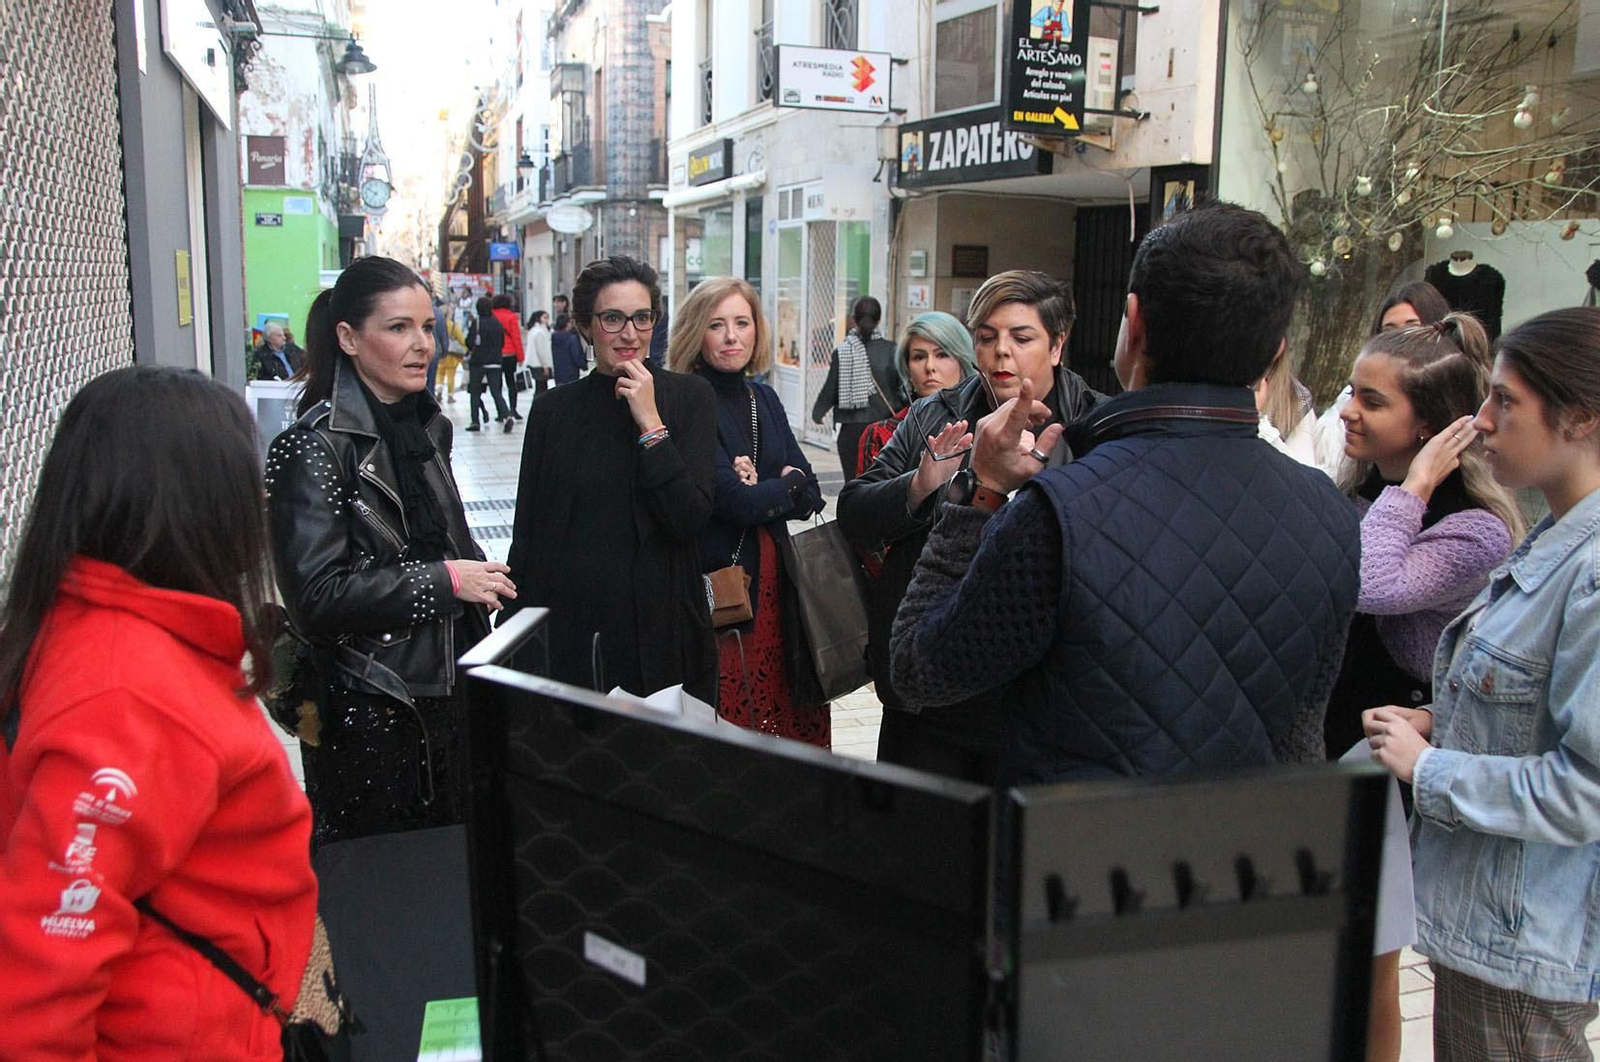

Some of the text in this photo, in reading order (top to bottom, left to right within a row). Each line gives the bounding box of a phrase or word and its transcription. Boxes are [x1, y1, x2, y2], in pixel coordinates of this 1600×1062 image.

[1019, 38, 1032, 48] EL
[1017, 49, 1081, 66] ARTESANO
[792, 61, 843, 70] ATRESMEDIA
[1026, 67, 1048, 79] Arreglo
[1055, 71, 1071, 80] venta
[1031, 78, 1041, 88] del
[1051, 93, 1059, 101] en
[1060, 93, 1072, 103] piel
[1013, 111, 1024, 121] EN
[40, 915, 96, 933] HUELVA
